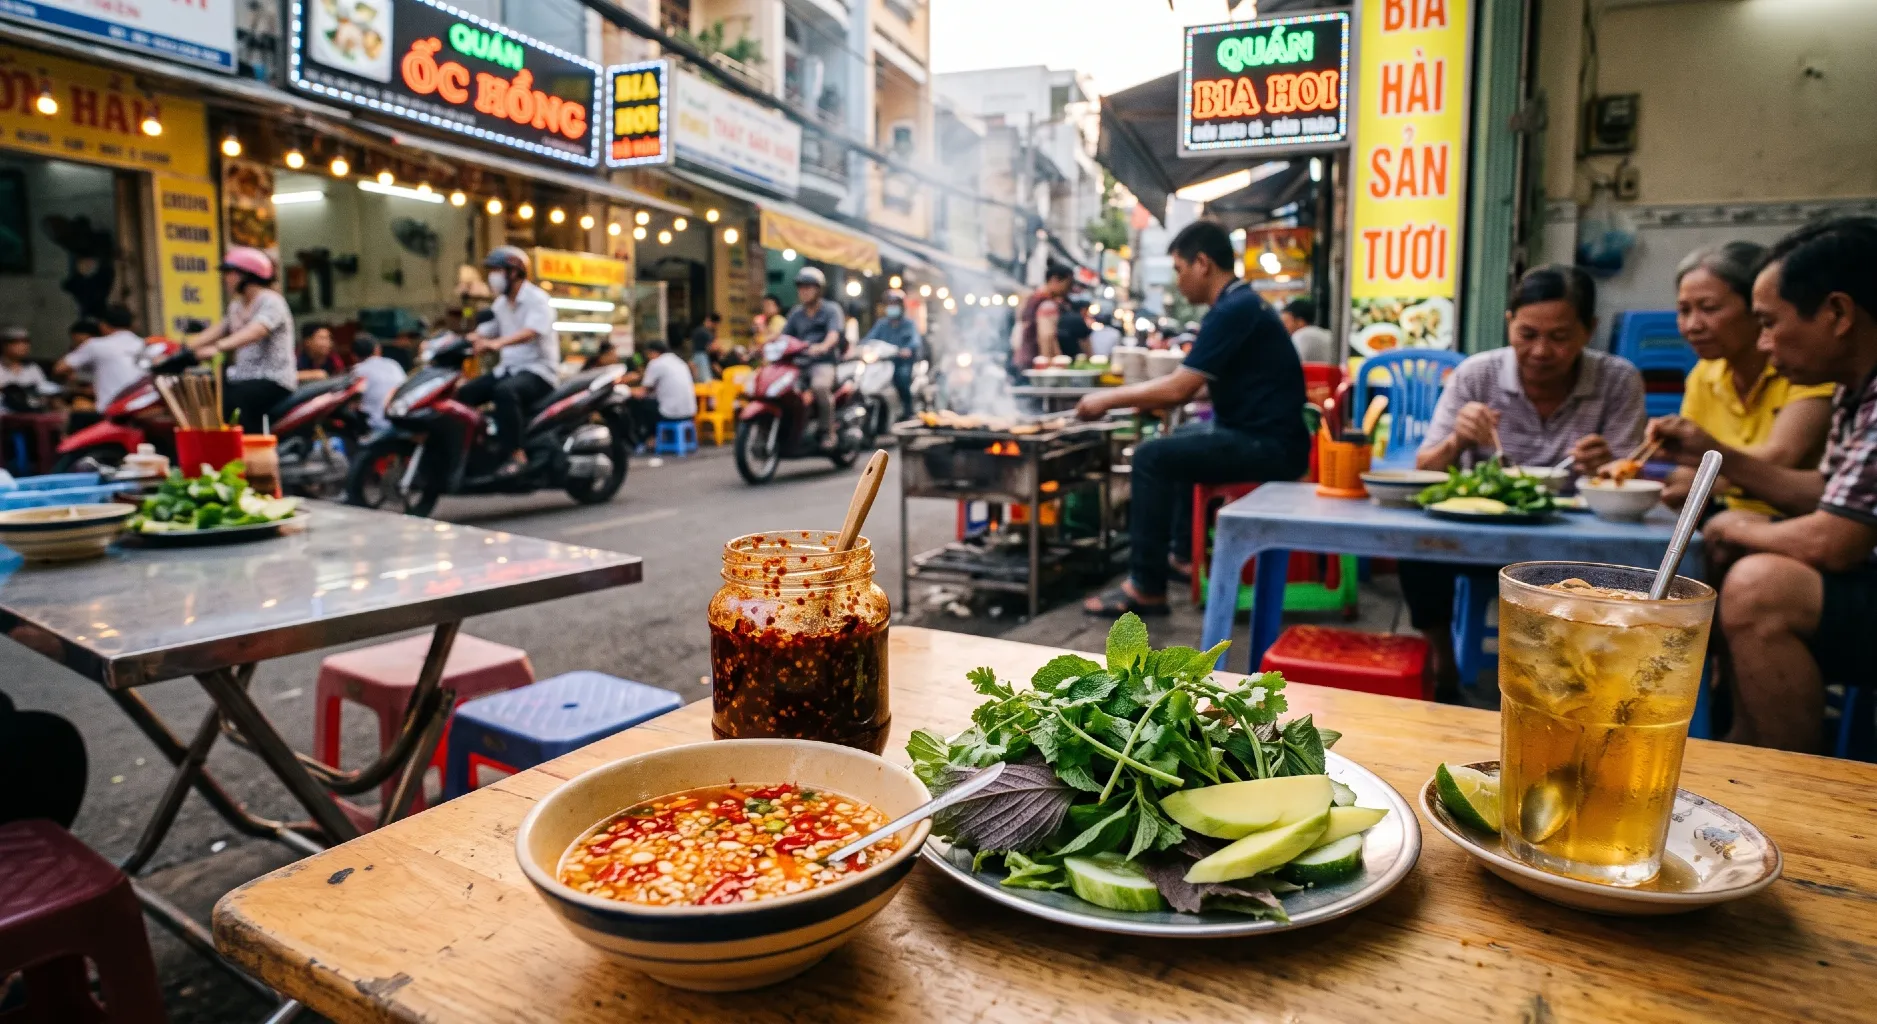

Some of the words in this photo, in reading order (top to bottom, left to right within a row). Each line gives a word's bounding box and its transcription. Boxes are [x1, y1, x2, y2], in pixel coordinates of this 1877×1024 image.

[1384, 0, 1445, 31] BIA
[402, 37, 470, 104] ỐC
[449, 22, 524, 71] QUÁN
[1217, 25, 1315, 73] QUÁN
[1192, 77, 1261, 119] BIA
[1265, 70, 1339, 114] HOI
[1369, 127, 1448, 198] SẢN
[1363, 223, 1447, 280] TƯƠI
